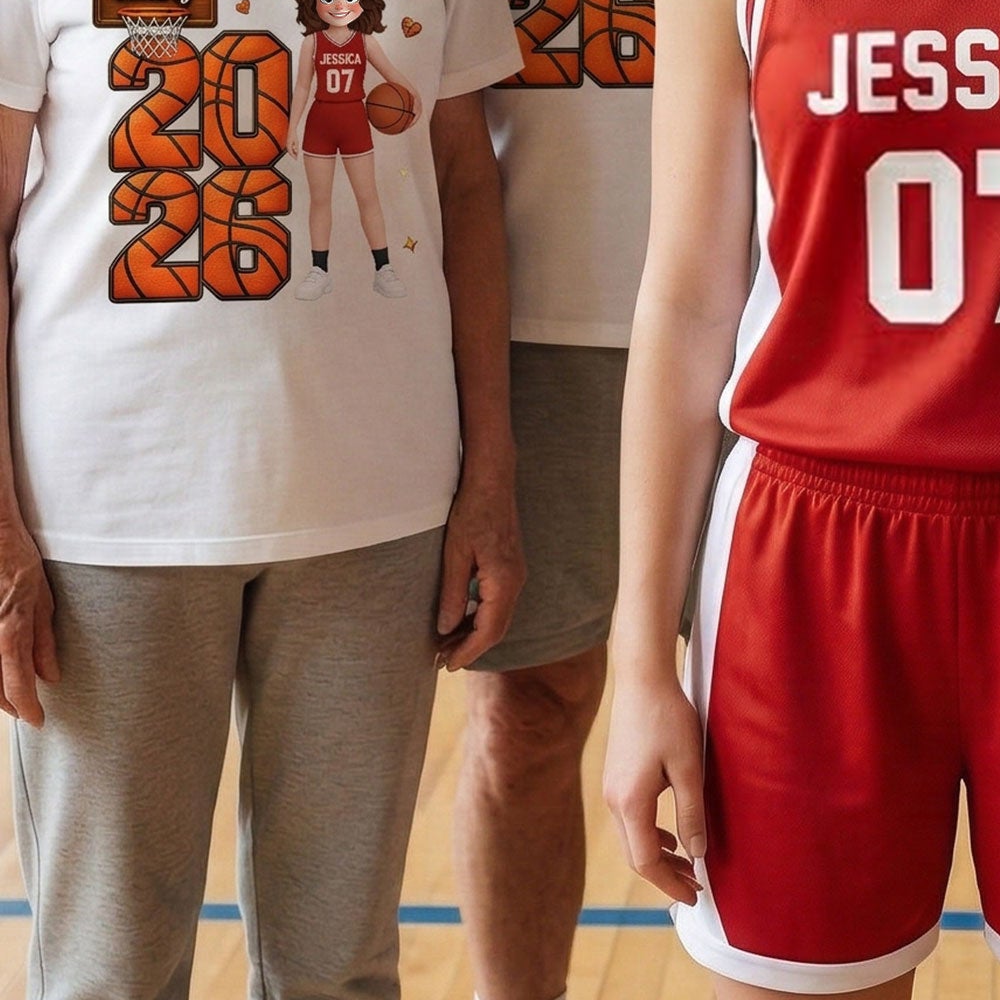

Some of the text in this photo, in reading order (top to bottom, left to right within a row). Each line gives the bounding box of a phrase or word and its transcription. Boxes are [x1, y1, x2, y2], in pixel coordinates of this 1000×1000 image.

[319, 53, 362, 65] JESSICA
[326, 68, 355, 94] 07
[109, 29, 293, 172] 20
[109, 167, 293, 303] 26
